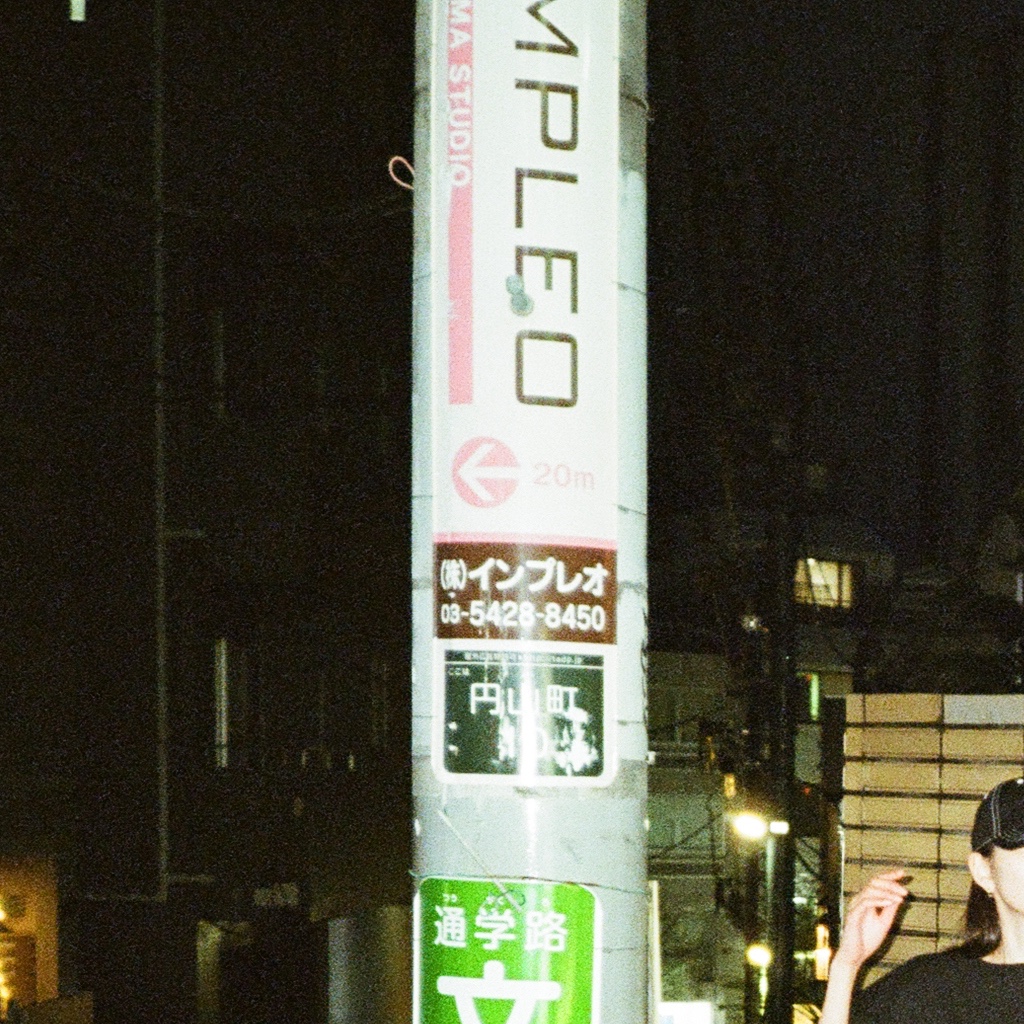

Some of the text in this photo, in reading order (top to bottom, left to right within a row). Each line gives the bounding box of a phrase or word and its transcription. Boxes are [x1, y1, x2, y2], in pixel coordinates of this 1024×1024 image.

[449, 64, 473, 189] STUDIO
[533, 462, 597, 491] 20m
[440, 600, 606, 631] 03-5428-8450
[434, 904, 567, 953] 通学路
